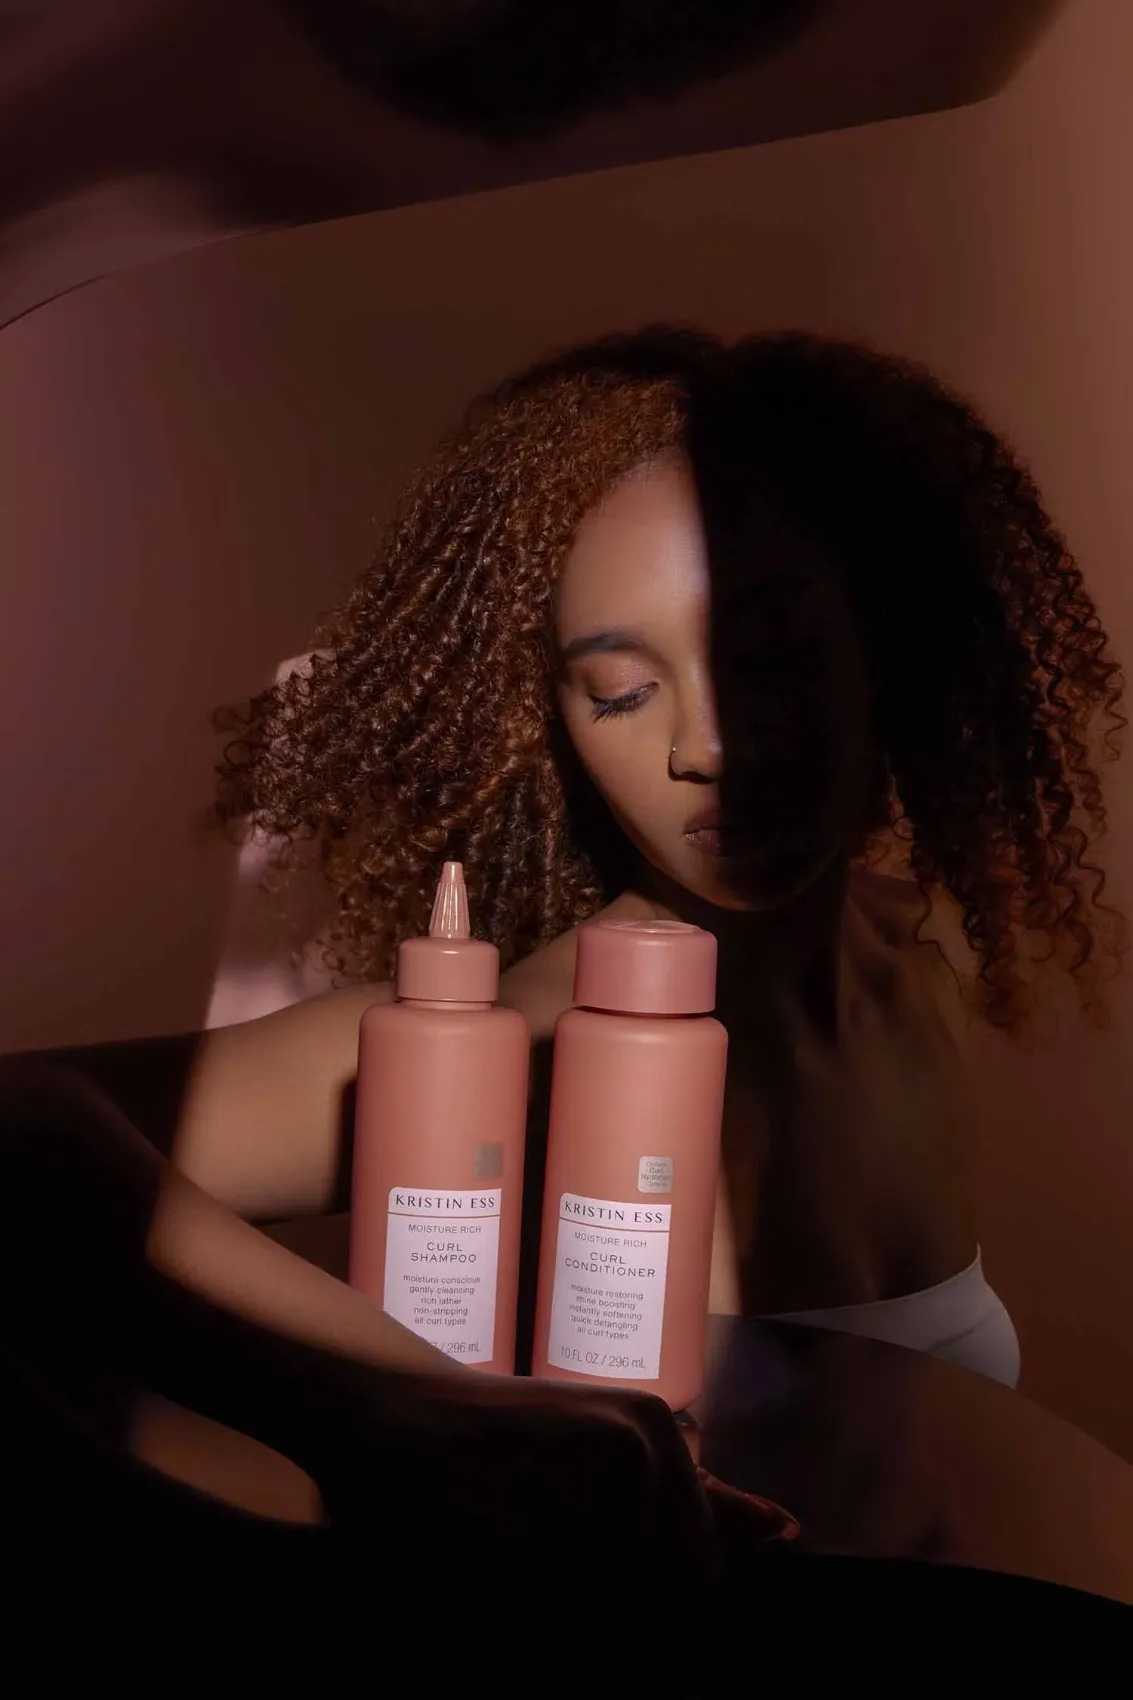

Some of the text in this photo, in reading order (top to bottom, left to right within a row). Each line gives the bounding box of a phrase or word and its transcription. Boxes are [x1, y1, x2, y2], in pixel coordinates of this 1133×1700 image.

[396, 1194, 495, 1209] KRISTIN ESS
[565, 1201, 664, 1223] KRISTIN ESS
[408, 1224, 457, 1233] MOISTURE
[574, 1232, 647, 1248] MOISTURE RICH
[427, 1242, 463, 1252] CURL
[411, 1253, 477, 1263] SHAMPOO
[589, 1252, 626, 1264] CURL
[565, 1258, 656, 1277] CONDITIONER
[403, 1275, 481, 1284] moisture conscious
[409, 1286, 434, 1294] gently
[571, 1285, 644, 1300] moisture restoring
[576, 1296, 636, 1310] shine boosting
[414, 1307, 468, 1316] non-stripping
[569, 1305, 642, 1320] instantly softening
[444, 1318, 466, 1326] types
[571, 1315, 638, 1330] quick detangling
[588, 1329, 604, 1337] curl
[605, 1331, 629, 1340] types
[447, 1342, 465, 1353] 296
[468, 1342, 481, 1352] mL
[561, 1346, 570, 1360] 10
[572, 1350, 582, 1362] FL
[586, 1352, 599, 1364] OZ
[609, 1356, 629, 1368] 296
[632, 1359, 646, 1369] mL
